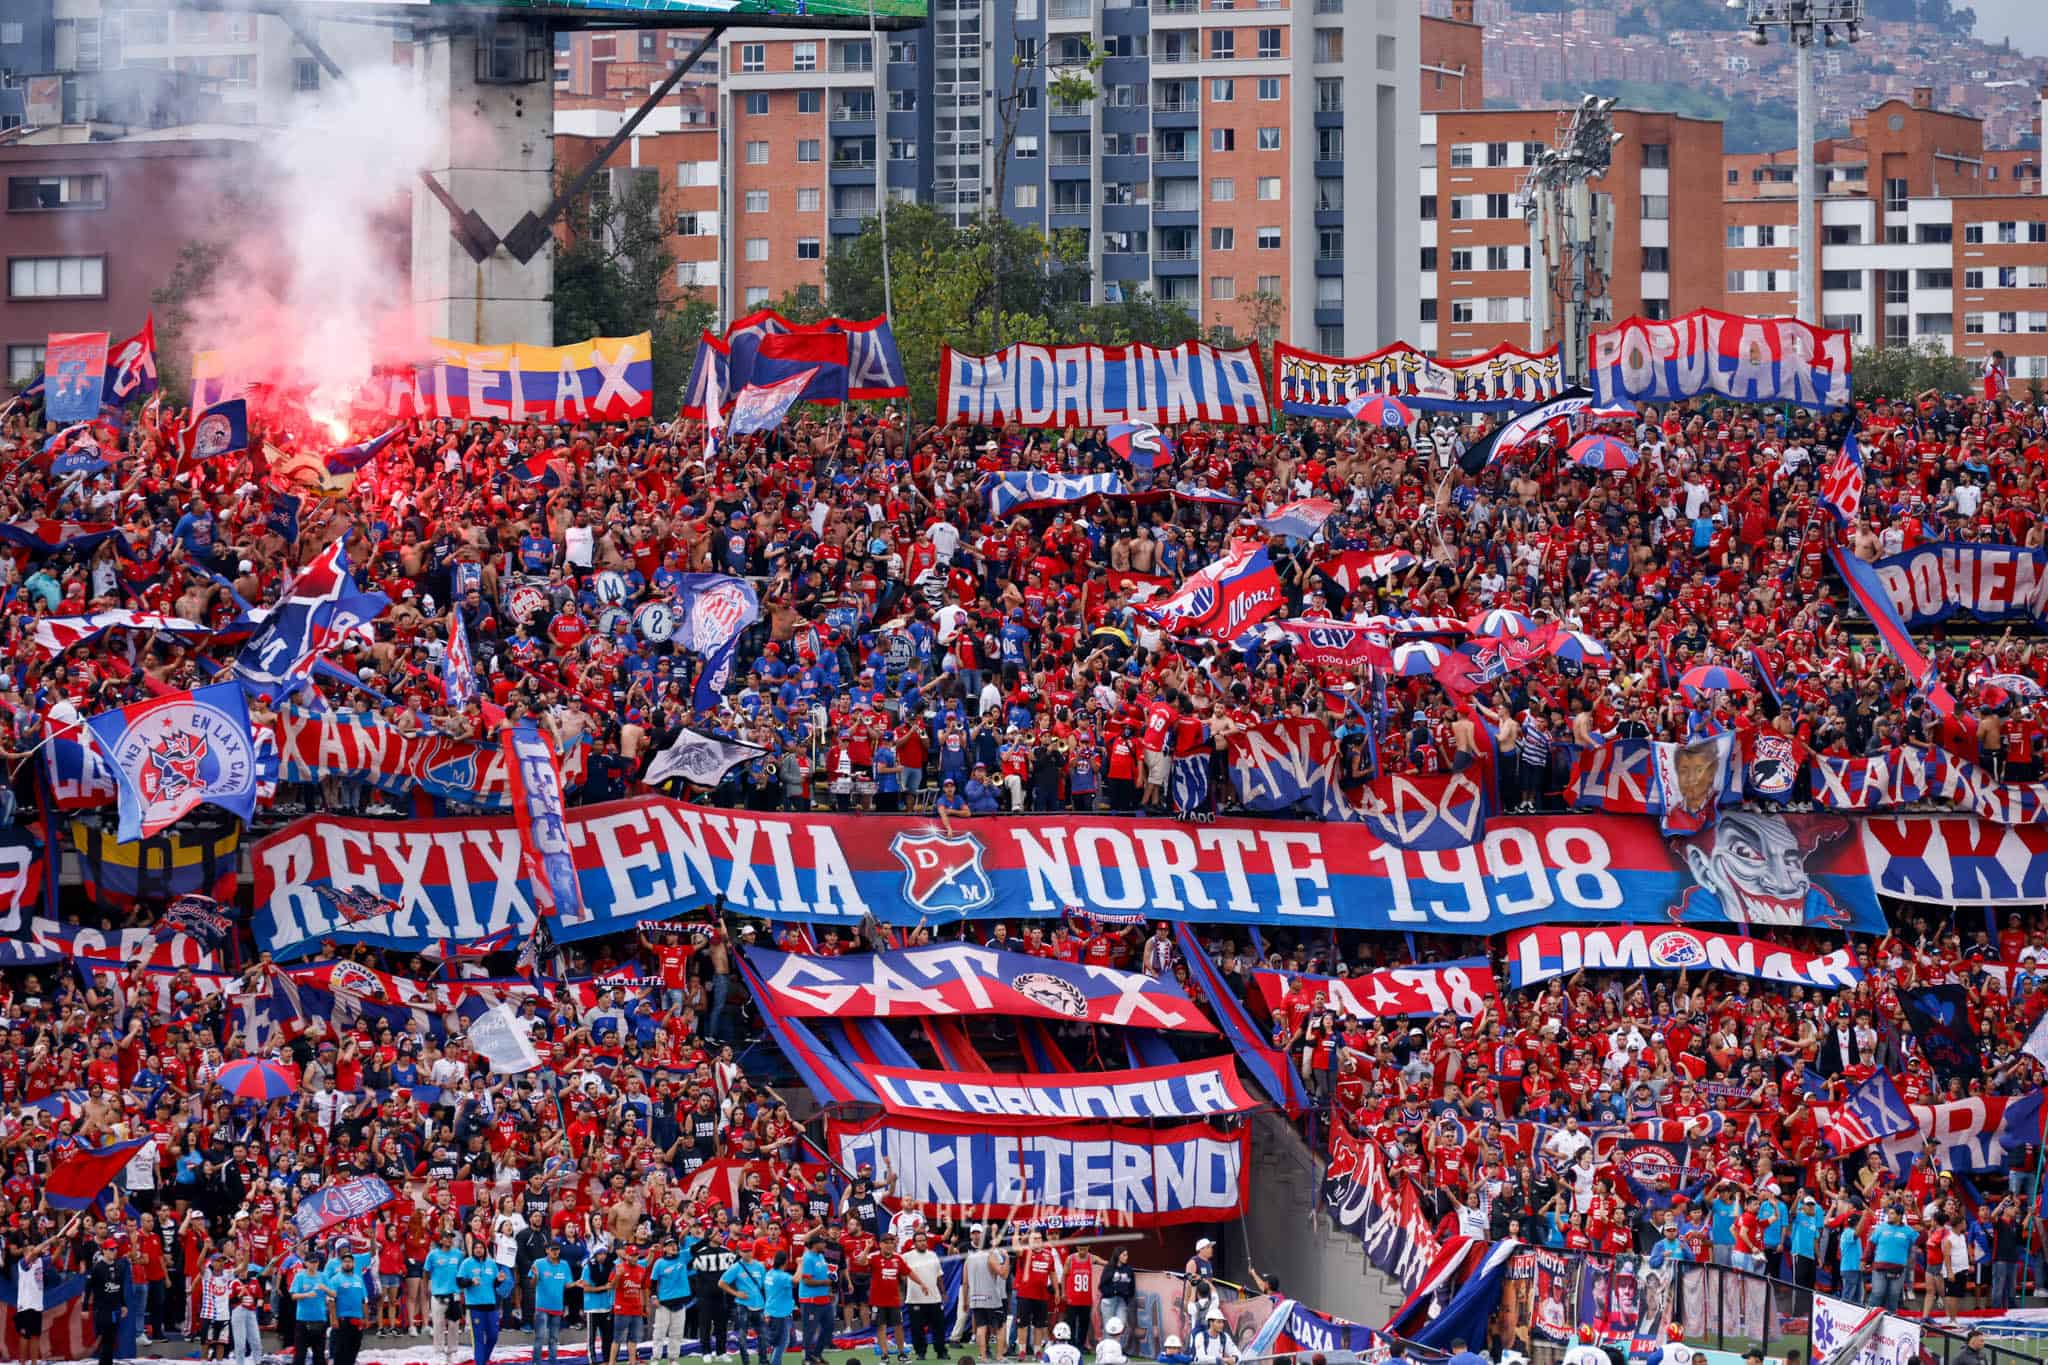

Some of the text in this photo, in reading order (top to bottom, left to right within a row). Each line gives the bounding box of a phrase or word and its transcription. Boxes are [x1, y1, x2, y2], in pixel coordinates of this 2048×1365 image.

[945, 342, 1265, 426] ANDALUXIA
[1595, 314, 1850, 407] POPULAR-1
[652, 610, 663, 634] 2
[190, 713, 211, 731] EN
[213, 723, 242, 756] LAX
[1011, 826, 1336, 918] NORTE
[1369, 826, 1625, 923] 1998
[873, 1074, 962, 1111] LA
[995, 1136, 1241, 1213] ETERNO
[1074, 1274, 1089, 1292] 98
